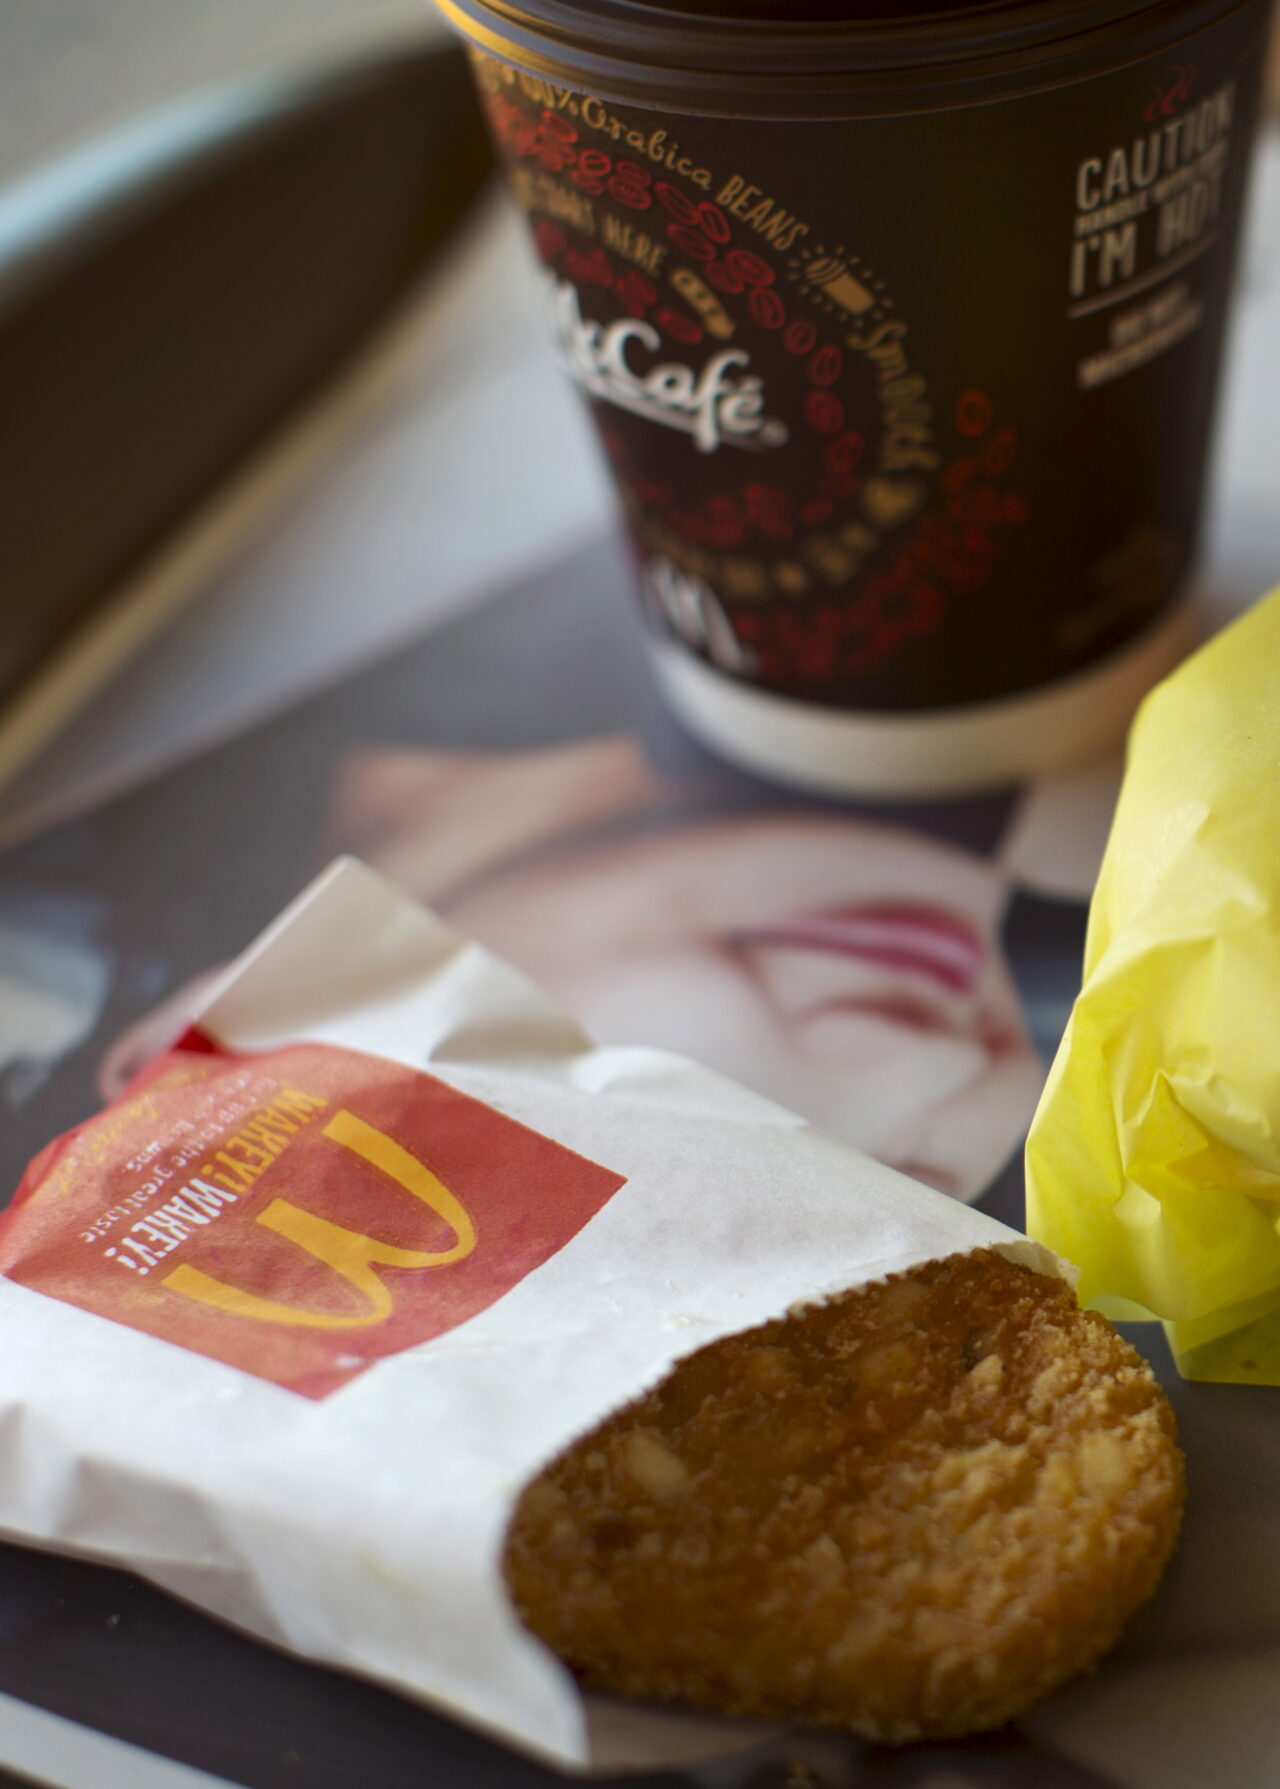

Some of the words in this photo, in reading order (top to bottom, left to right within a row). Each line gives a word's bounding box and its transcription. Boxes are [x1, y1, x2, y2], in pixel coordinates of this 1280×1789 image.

[582, 94, 713, 190] Arabica
[715, 174, 810, 251] BEANS
[1069, 221, 1138, 297] I'M
[201, 1088, 328, 1193] WAKEY!
[104, 1178, 238, 1276] WAKEY!
